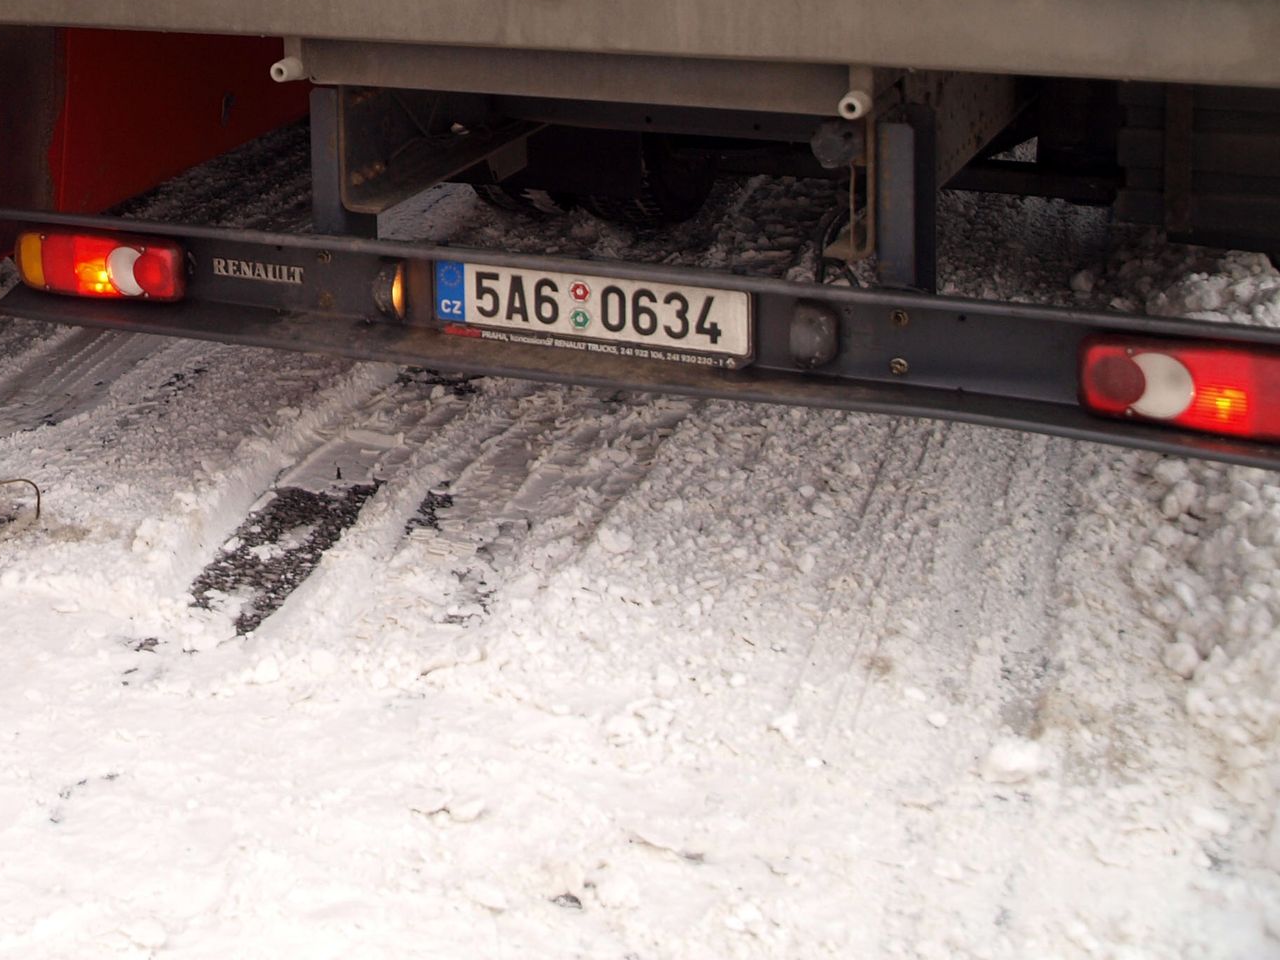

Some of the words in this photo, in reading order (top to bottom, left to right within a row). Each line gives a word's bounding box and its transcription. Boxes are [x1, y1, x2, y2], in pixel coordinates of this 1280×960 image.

[213, 257, 304, 285] RENAULT
[441, 299, 462, 315] CZ
[475, 271, 560, 325] 5A6
[600, 285, 722, 345] 0634
